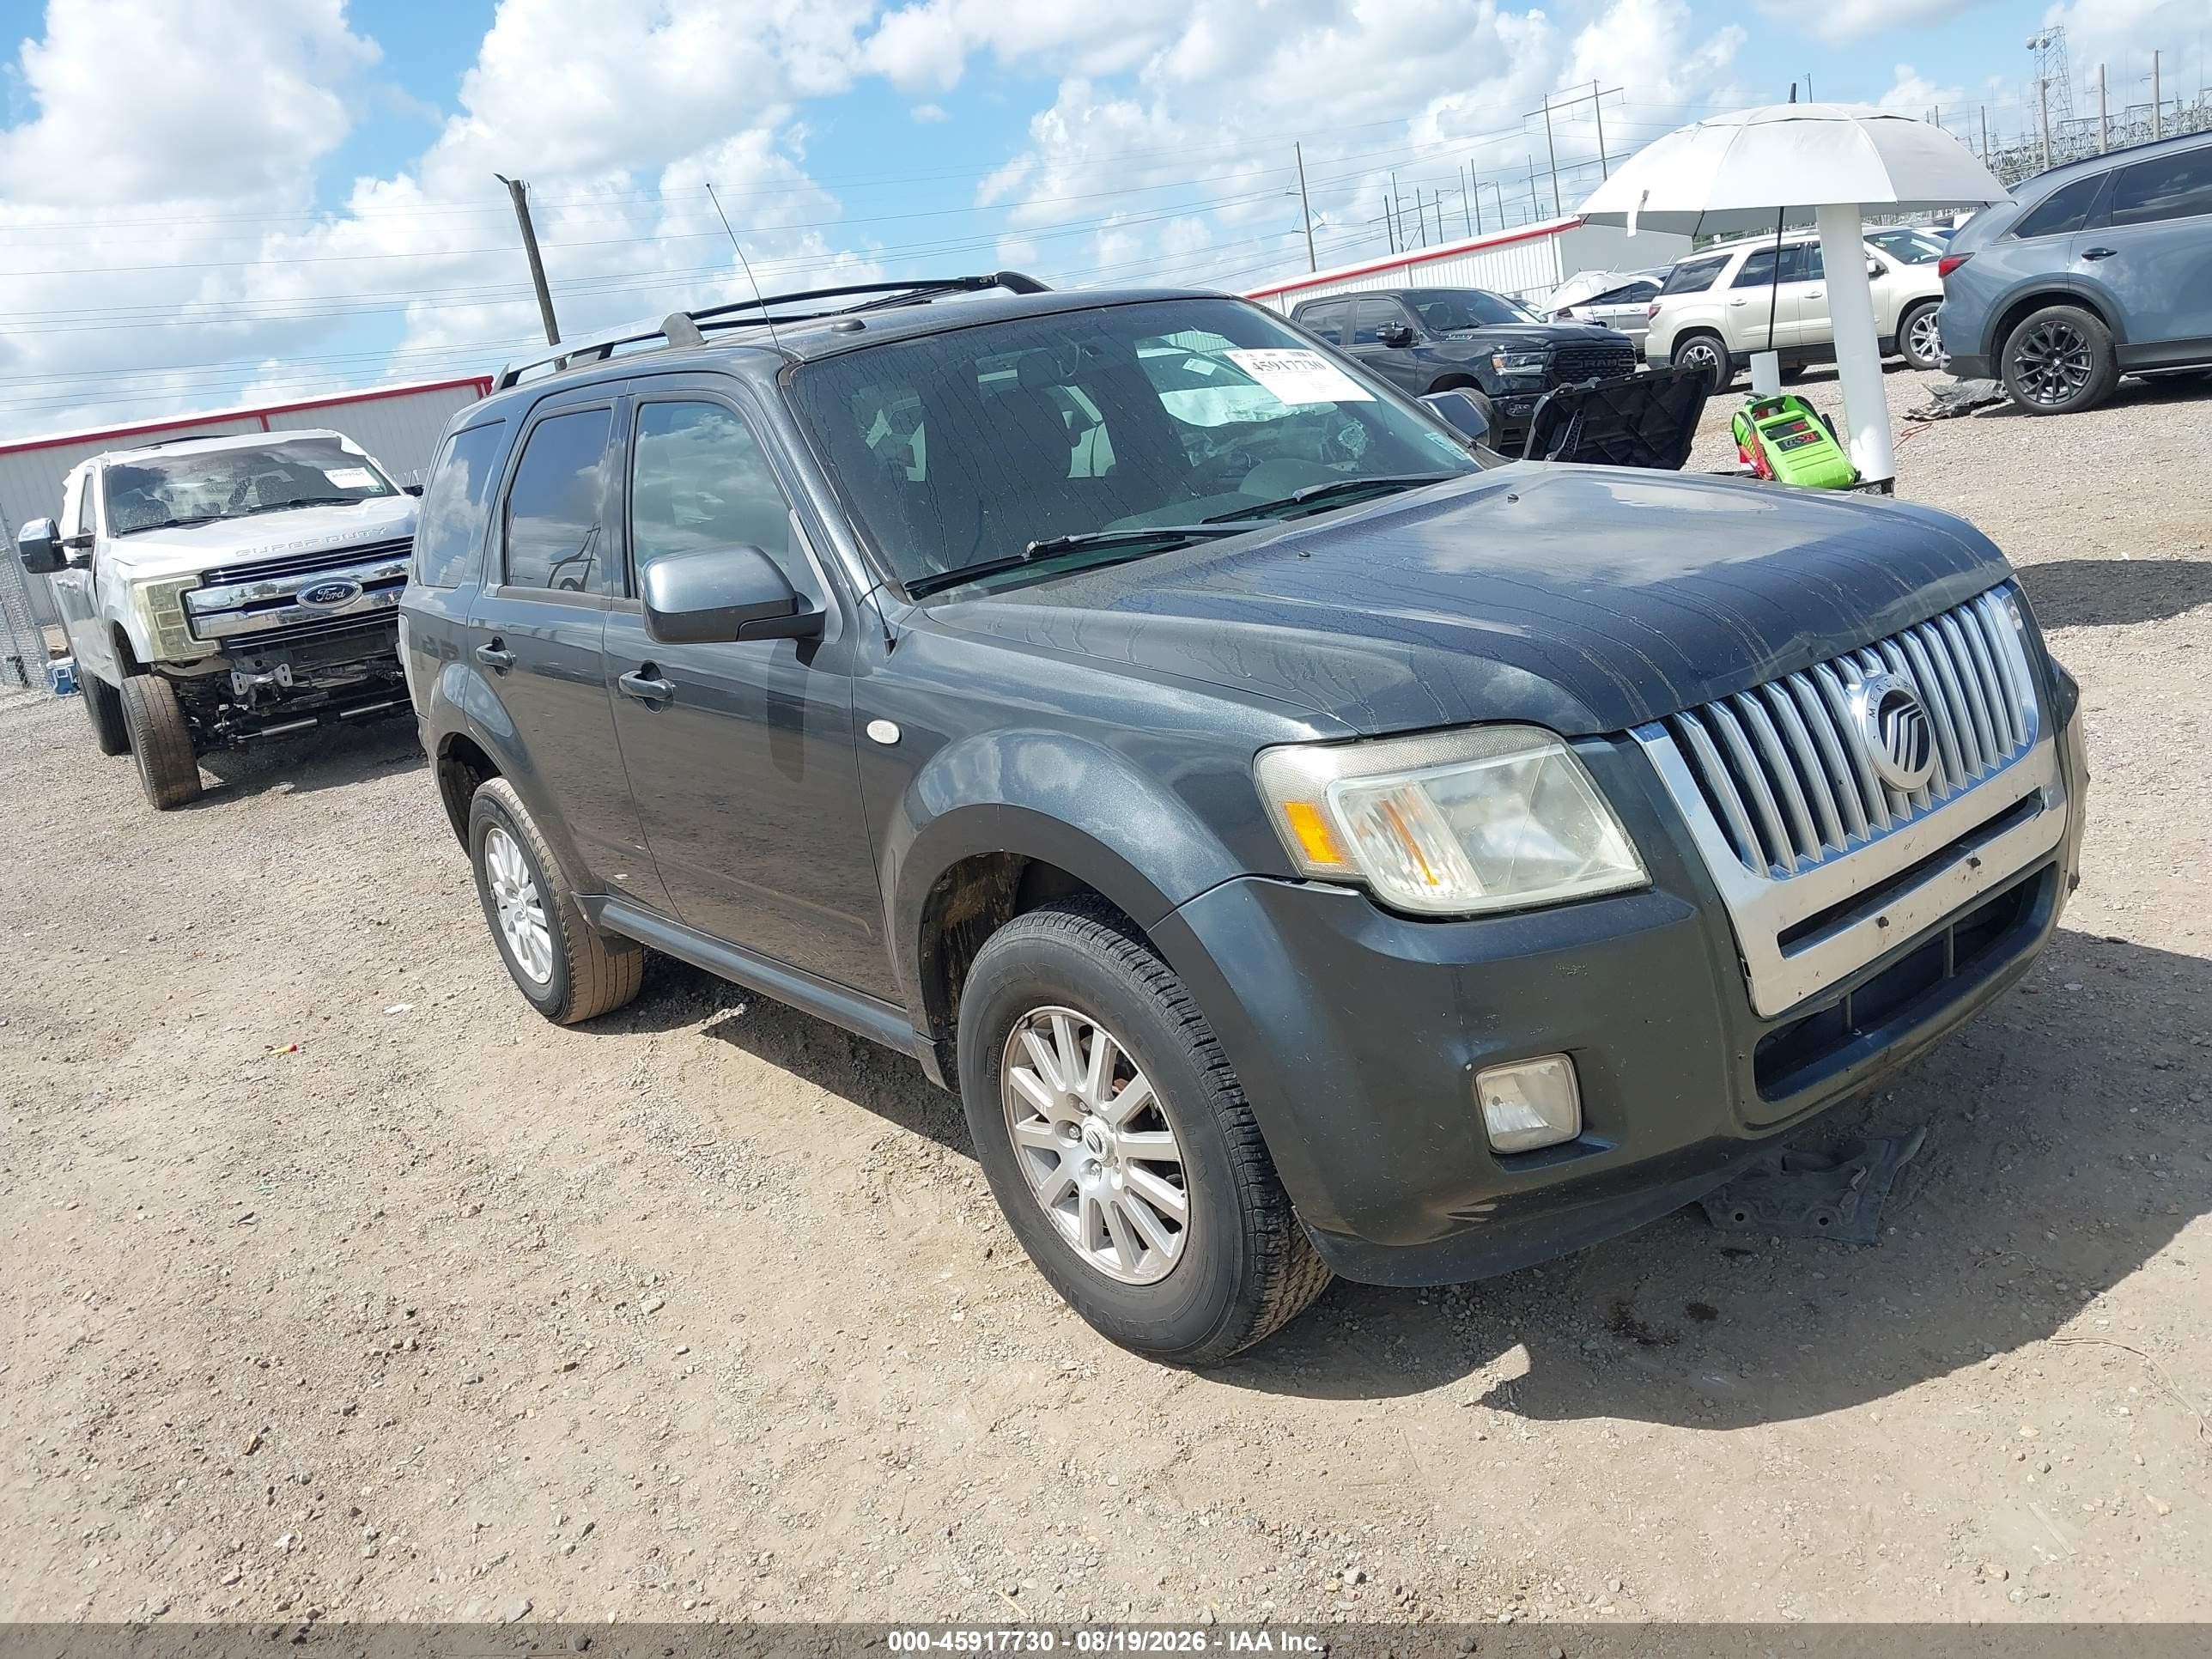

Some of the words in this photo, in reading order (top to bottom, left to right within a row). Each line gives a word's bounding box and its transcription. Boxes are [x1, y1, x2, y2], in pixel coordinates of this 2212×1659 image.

[1252, 360, 1327, 372] 45917730
[1583, 358, 1618, 368] RAM
[235, 538, 319, 557] SUPER
[325, 526, 387, 544] DUTY
[315, 586, 346, 602] Ford
